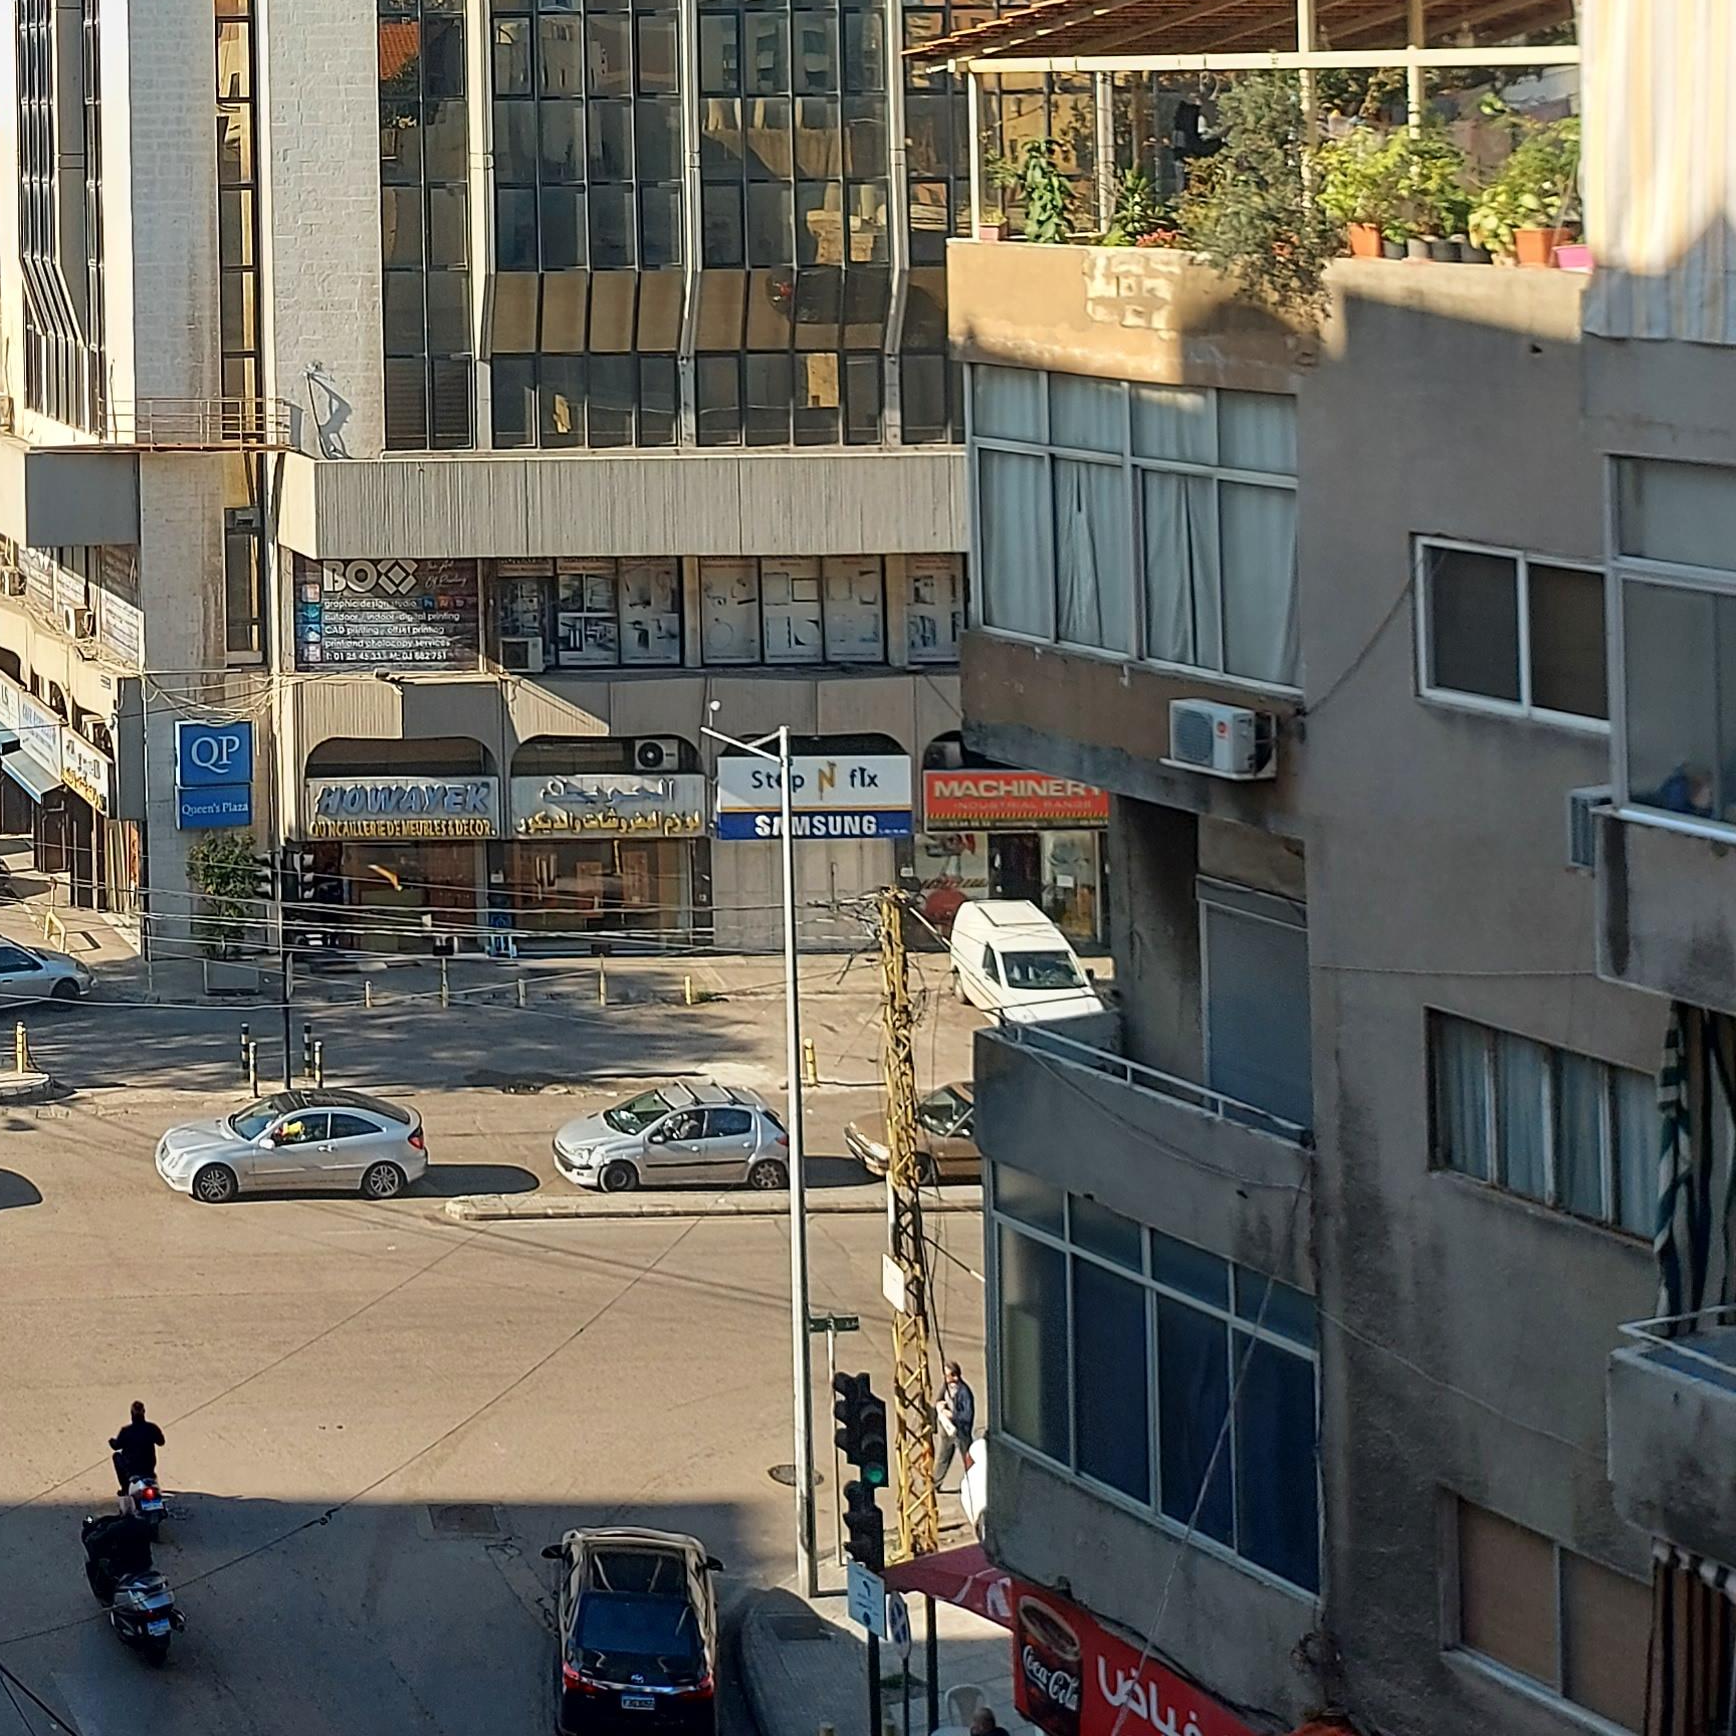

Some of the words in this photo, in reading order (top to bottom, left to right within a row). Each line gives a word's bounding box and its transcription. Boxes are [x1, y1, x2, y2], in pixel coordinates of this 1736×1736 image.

[324, 599, 359, 610] graphic
[360, 598, 389, 610] design
[325, 613, 359, 622] outdoor
[427, 612, 460, 622] printing
[324, 626, 345, 634] CAD
[347, 626, 379, 635] printing
[412, 625, 445, 635] printing
[325, 639, 344, 648] print
[345, 639, 363, 647] and
[365, 638, 413, 648] photocopy
[414, 639, 450, 647] services
[191, 735, 240, 774] QP
[315, 783, 491, 814] HOWAYEK
[954, 800, 1037, 810] INDUSTRIAL
[1043, 799, 1093, 809] RANGE
[181, 803, 221, 816] Queen's
[222, 802, 249, 812] Plaza
[310, 820, 386, 837] QUNCAILLERIE
[664, 810, 699, 836] لوزم
[755, 815, 877, 836] SAMSUNG
